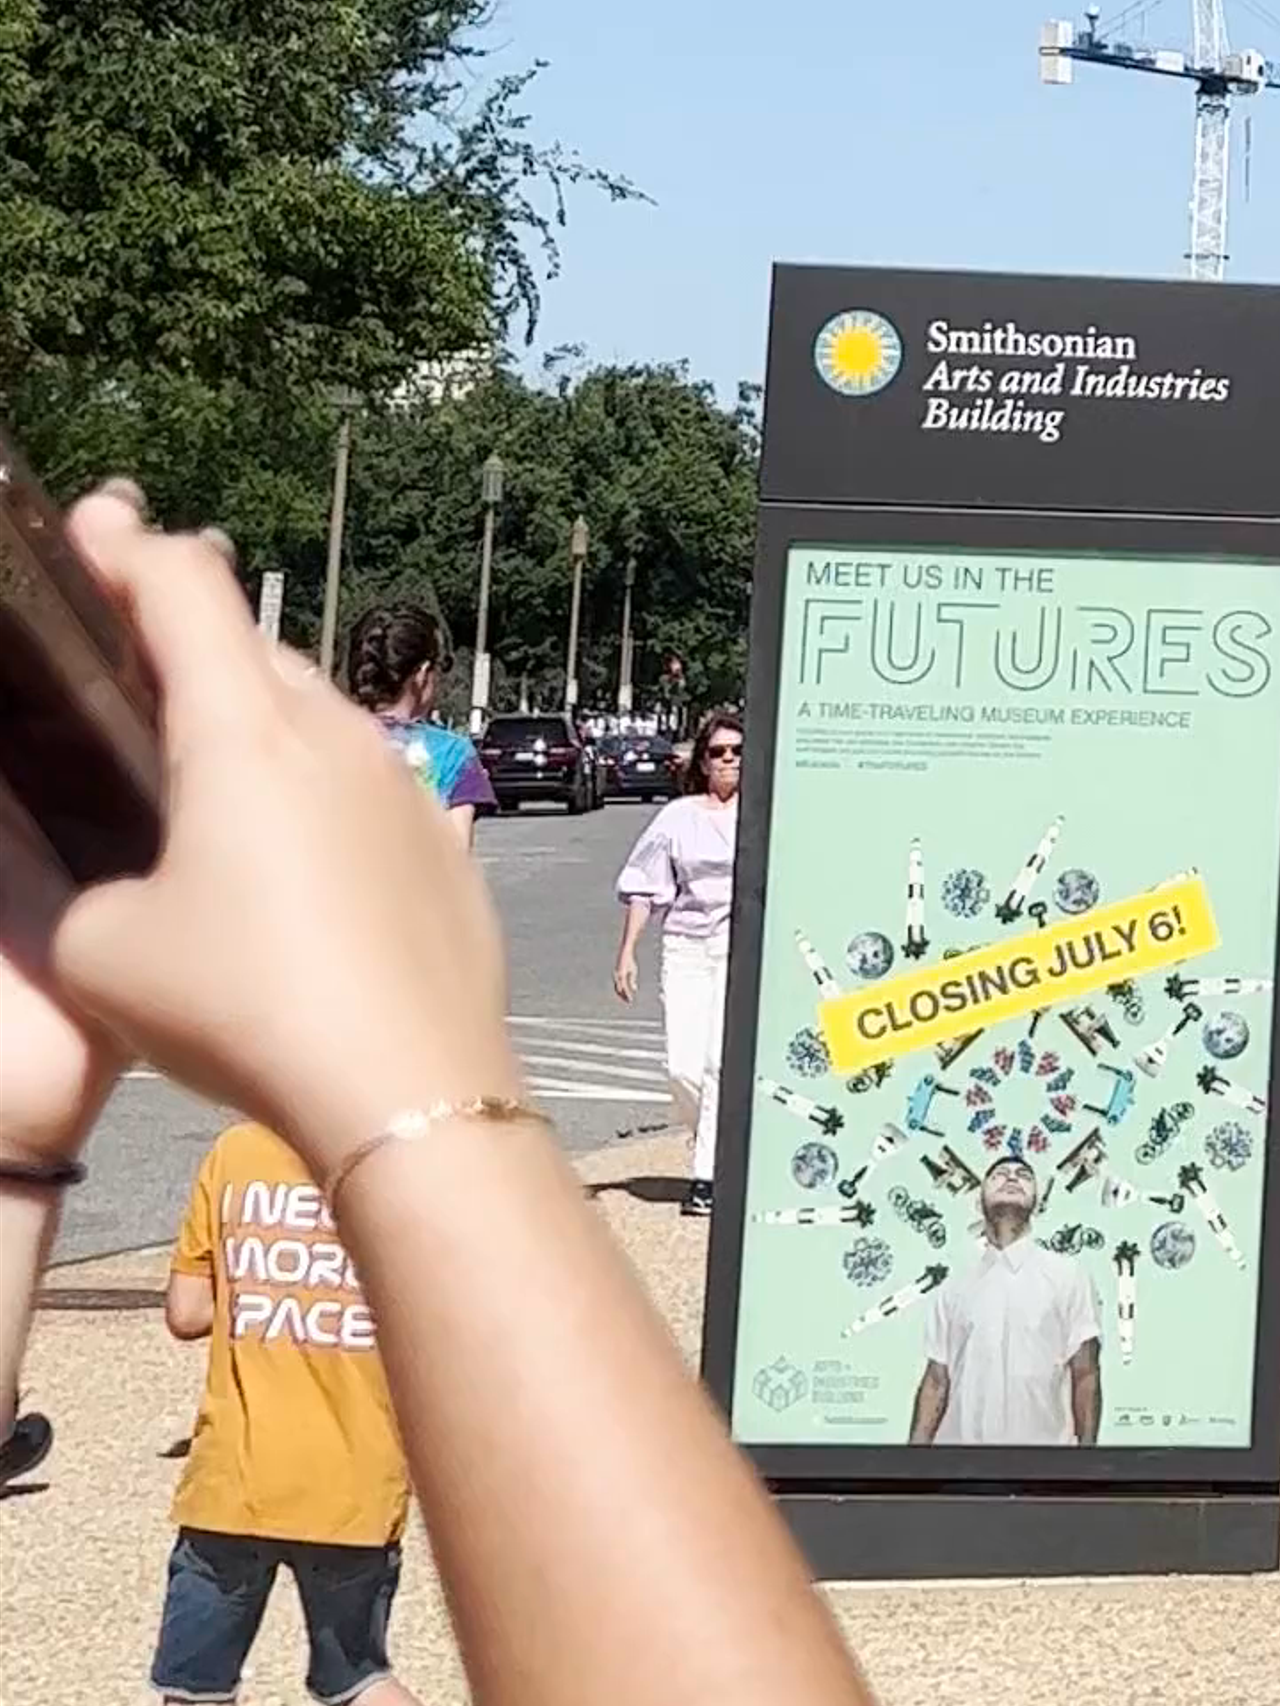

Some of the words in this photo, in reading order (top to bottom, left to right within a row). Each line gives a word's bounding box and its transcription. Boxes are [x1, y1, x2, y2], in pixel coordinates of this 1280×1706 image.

[926, 320, 1137, 360] Smithsonian
[921, 359, 994, 393] Arts
[999, 362, 1065, 395] and
[1070, 364, 1230, 402] Industries
[920, 397, 1065, 443] Building
[806, 560, 892, 588] MEET
[902, 563, 943, 590] US
[953, 566, 983, 591] IN
[994, 566, 1055, 593] THE
[799, 598, 1272, 698] FUTURES
[797, 701, 811, 718] A
[818, 702, 975, 724] TIME-TRAVELING
[980, 707, 1065, 726] MUSEUM
[1071, 708, 1192, 729] EXPERIENCE
[856, 955, 1042, 1041] CLOSING
[1046, 919, 1138, 978] JULY
[1148, 905, 1187, 943] 6!
[221, 1183, 233, 1224] I
[235, 1292, 377, 1347] PACE
